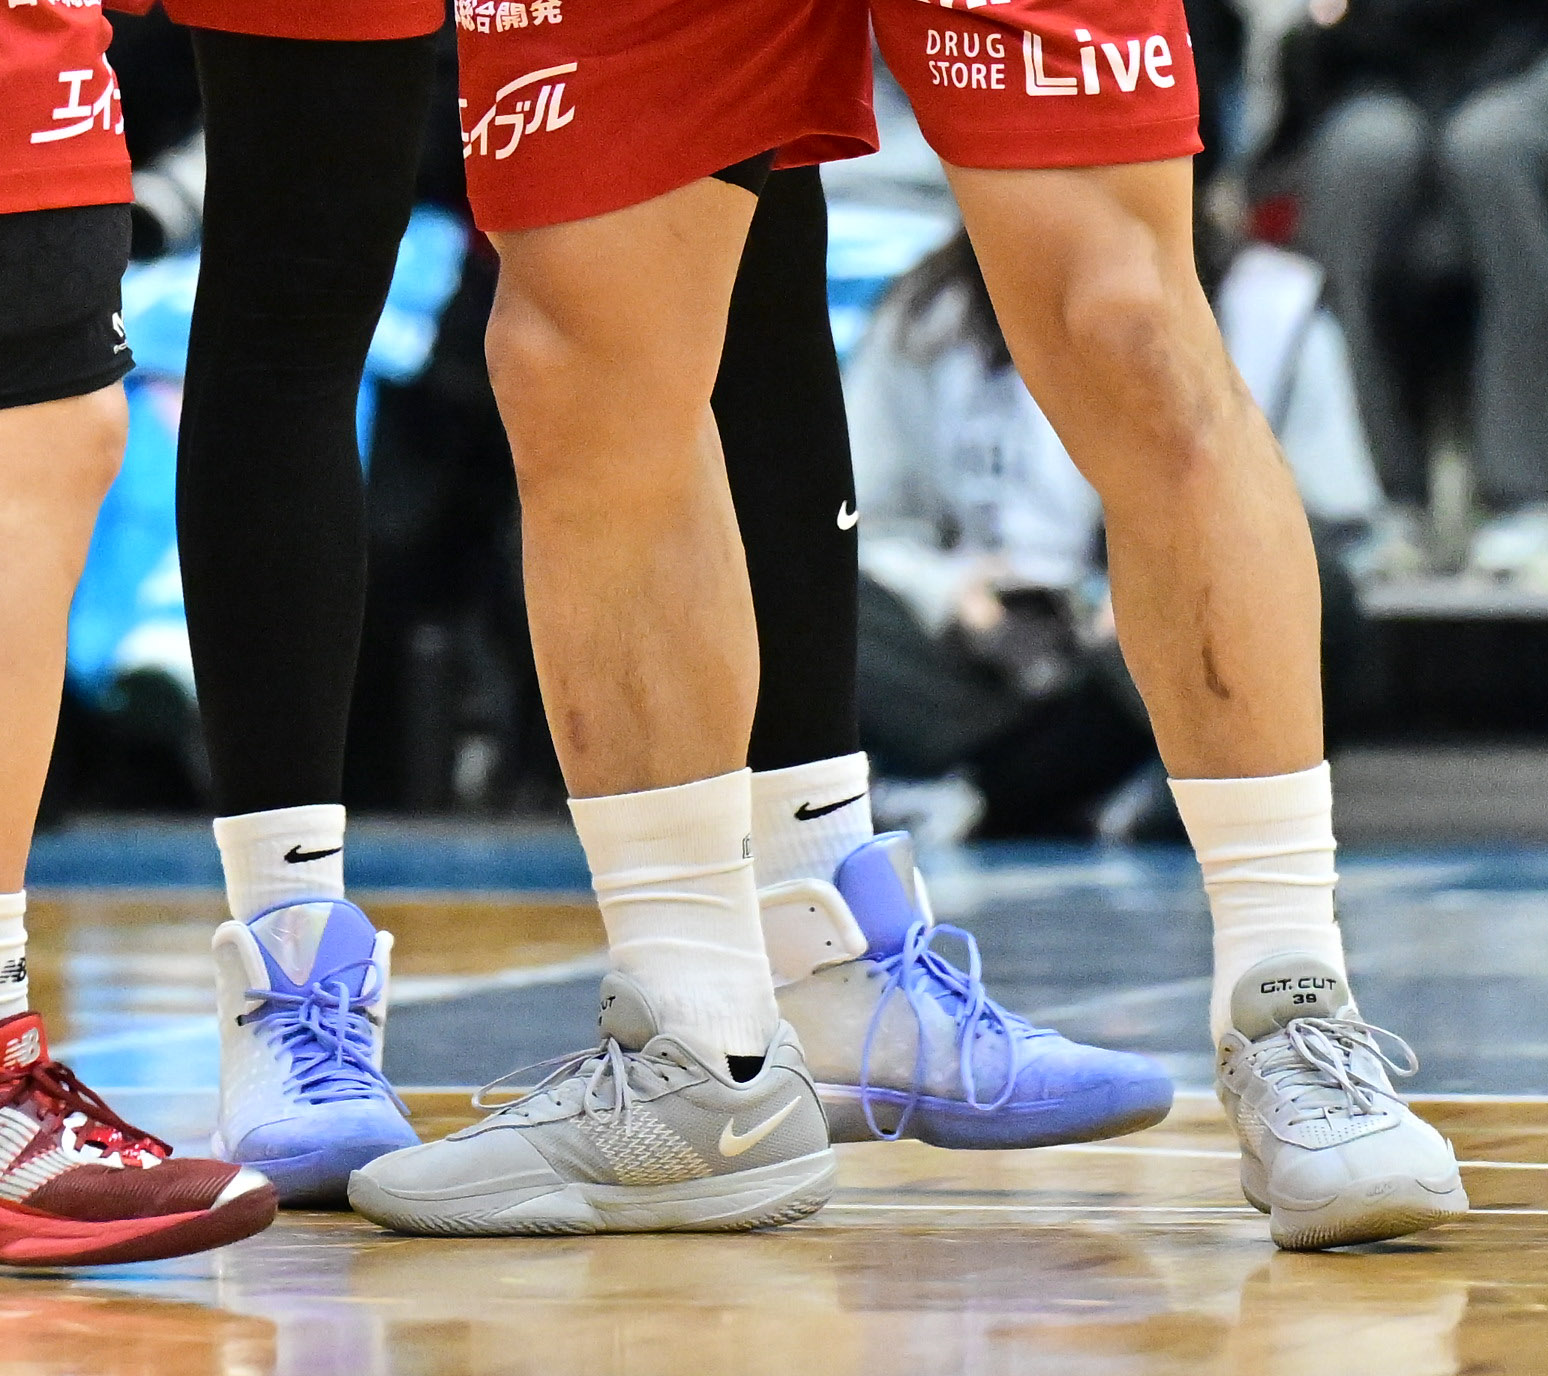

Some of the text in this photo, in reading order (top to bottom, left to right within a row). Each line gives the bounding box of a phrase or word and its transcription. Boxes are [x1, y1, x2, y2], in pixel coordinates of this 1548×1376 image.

[926, 28, 1006, 59] DRUG
[929, 59, 1006, 90] STORE
[1022, 28, 1176, 97] Live
[1298, 977, 1336, 990] CUT
